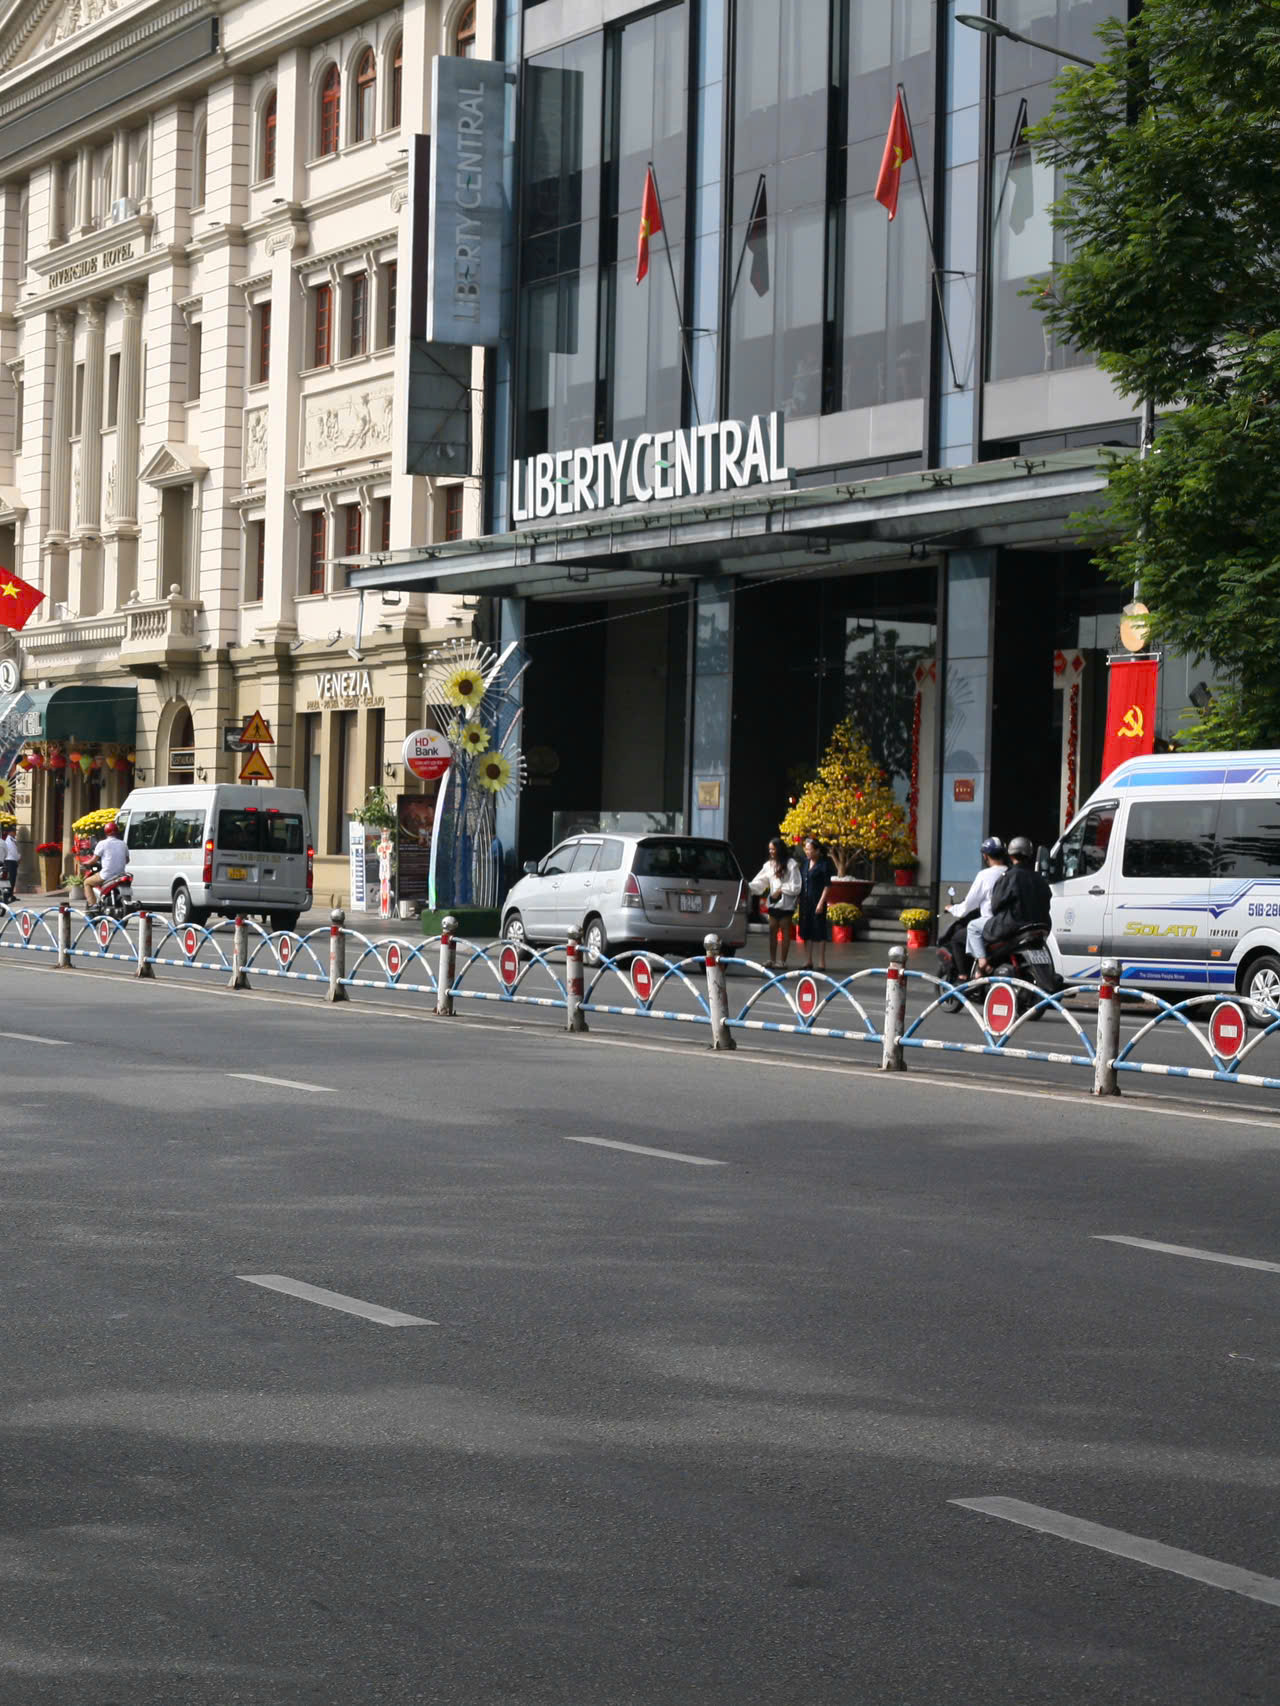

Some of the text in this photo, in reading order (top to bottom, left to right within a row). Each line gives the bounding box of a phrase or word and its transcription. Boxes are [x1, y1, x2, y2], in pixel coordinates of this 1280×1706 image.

[49, 243, 134, 289] RIVERSIDE HOTEL
[314, 671, 373, 697] VENEZIA
[415, 737, 429, 747] HD
[415, 747, 439, 756] Bank
[1123, 921, 1198, 937] SOLATI
[1209, 928, 1239, 938] TOP SPEED
